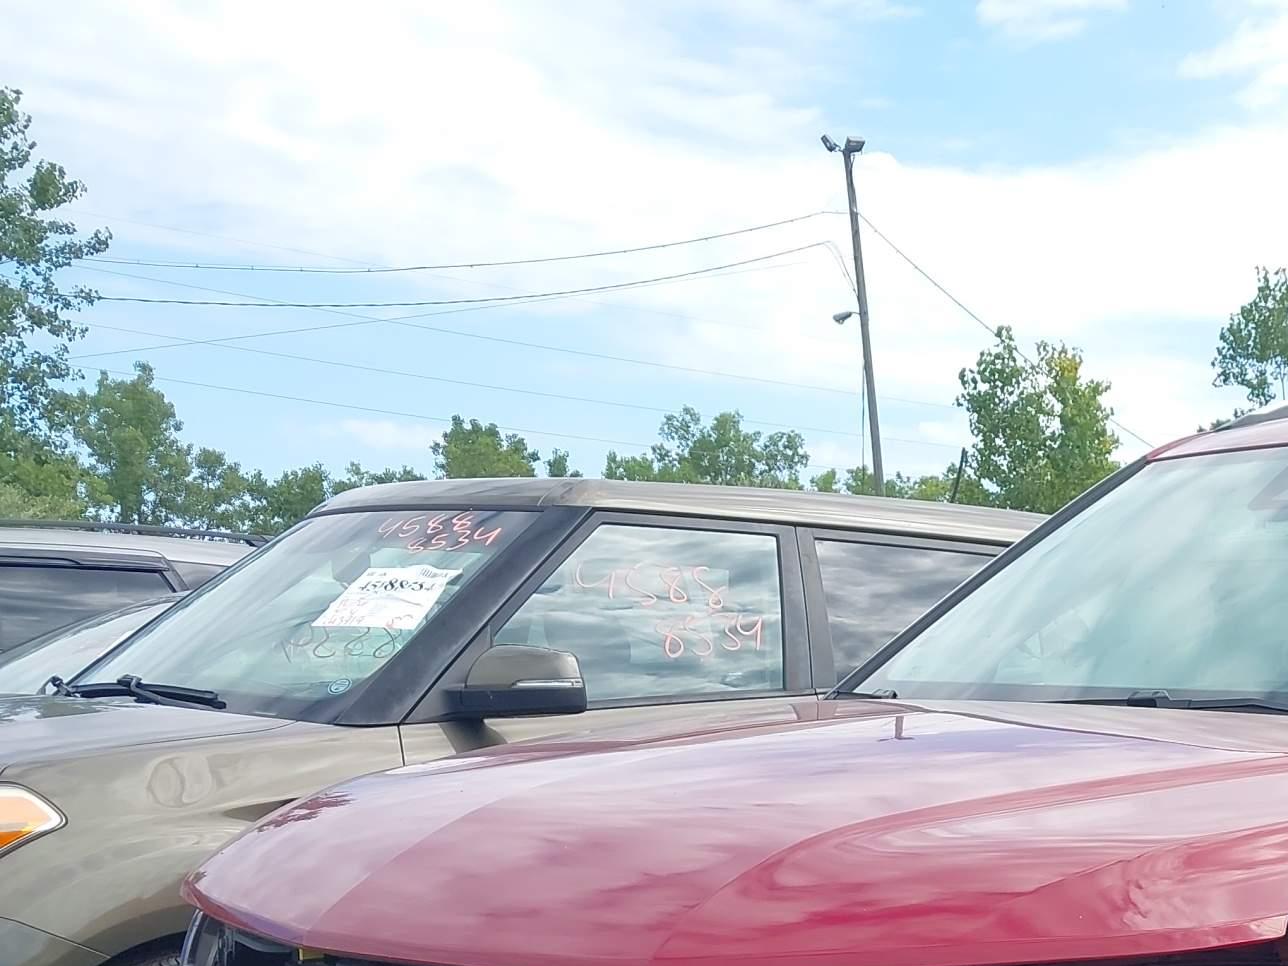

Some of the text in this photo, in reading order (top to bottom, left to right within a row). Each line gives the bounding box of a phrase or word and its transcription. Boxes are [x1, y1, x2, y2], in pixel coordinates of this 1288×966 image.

[378, 512, 473, 538] 4588
[575, 559, 727, 610] 4588
[655, 612, 763, 659] 8534
